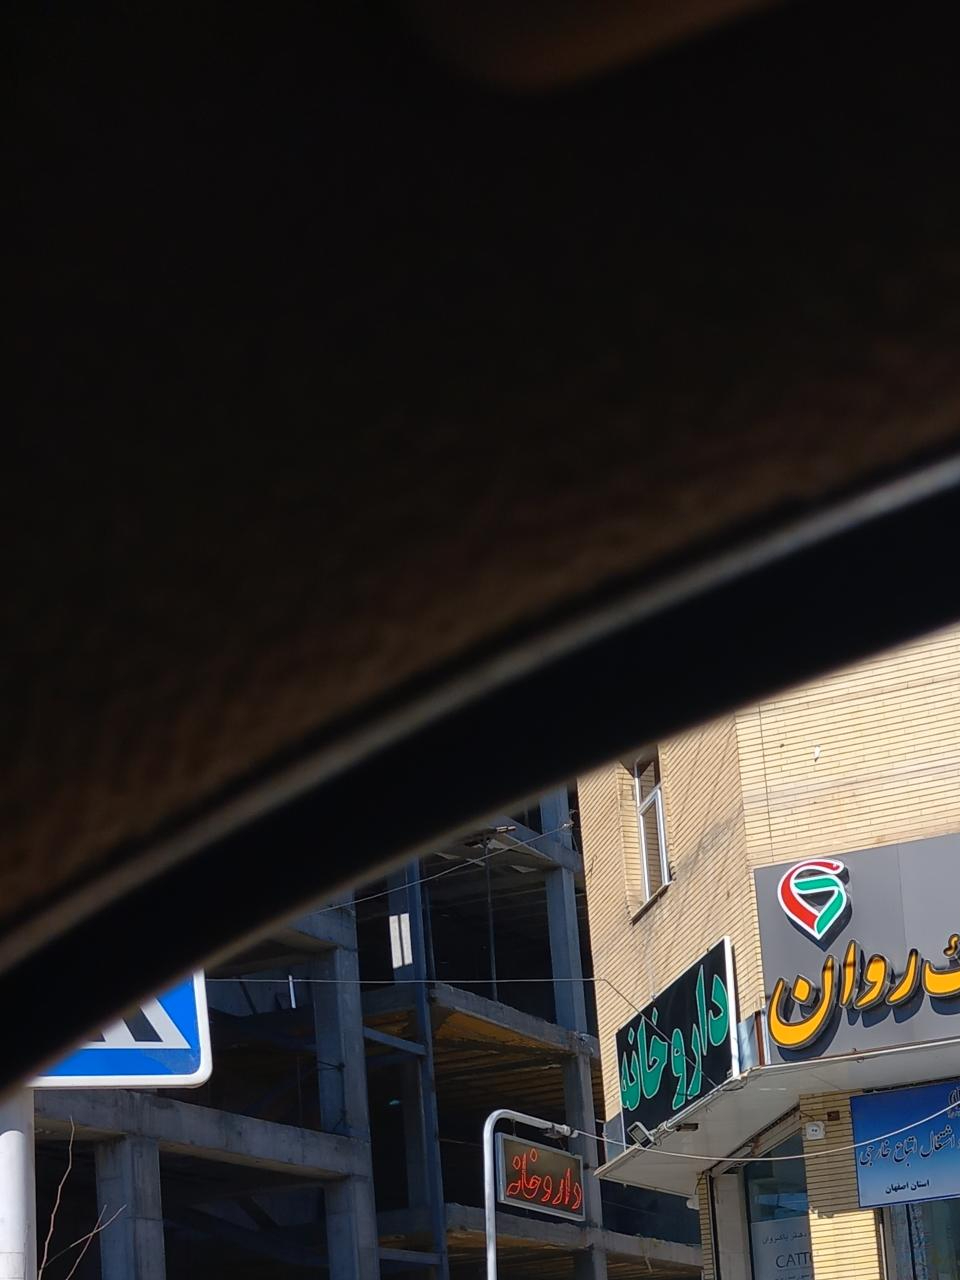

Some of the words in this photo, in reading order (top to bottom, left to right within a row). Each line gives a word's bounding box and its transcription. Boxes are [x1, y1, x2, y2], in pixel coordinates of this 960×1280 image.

[620, 964, 730, 1111] داروخانه
[858, 1140, 891, 1167] خارجی
[892, 1135, 918, 1167] اتباع
[919, 1123, 956, 1158] اشتغال
[884, 1182, 909, 1195] اصفهان
[909, 1179, 930, 1192] استان
[775, 1251, 812, 1269] CATT
